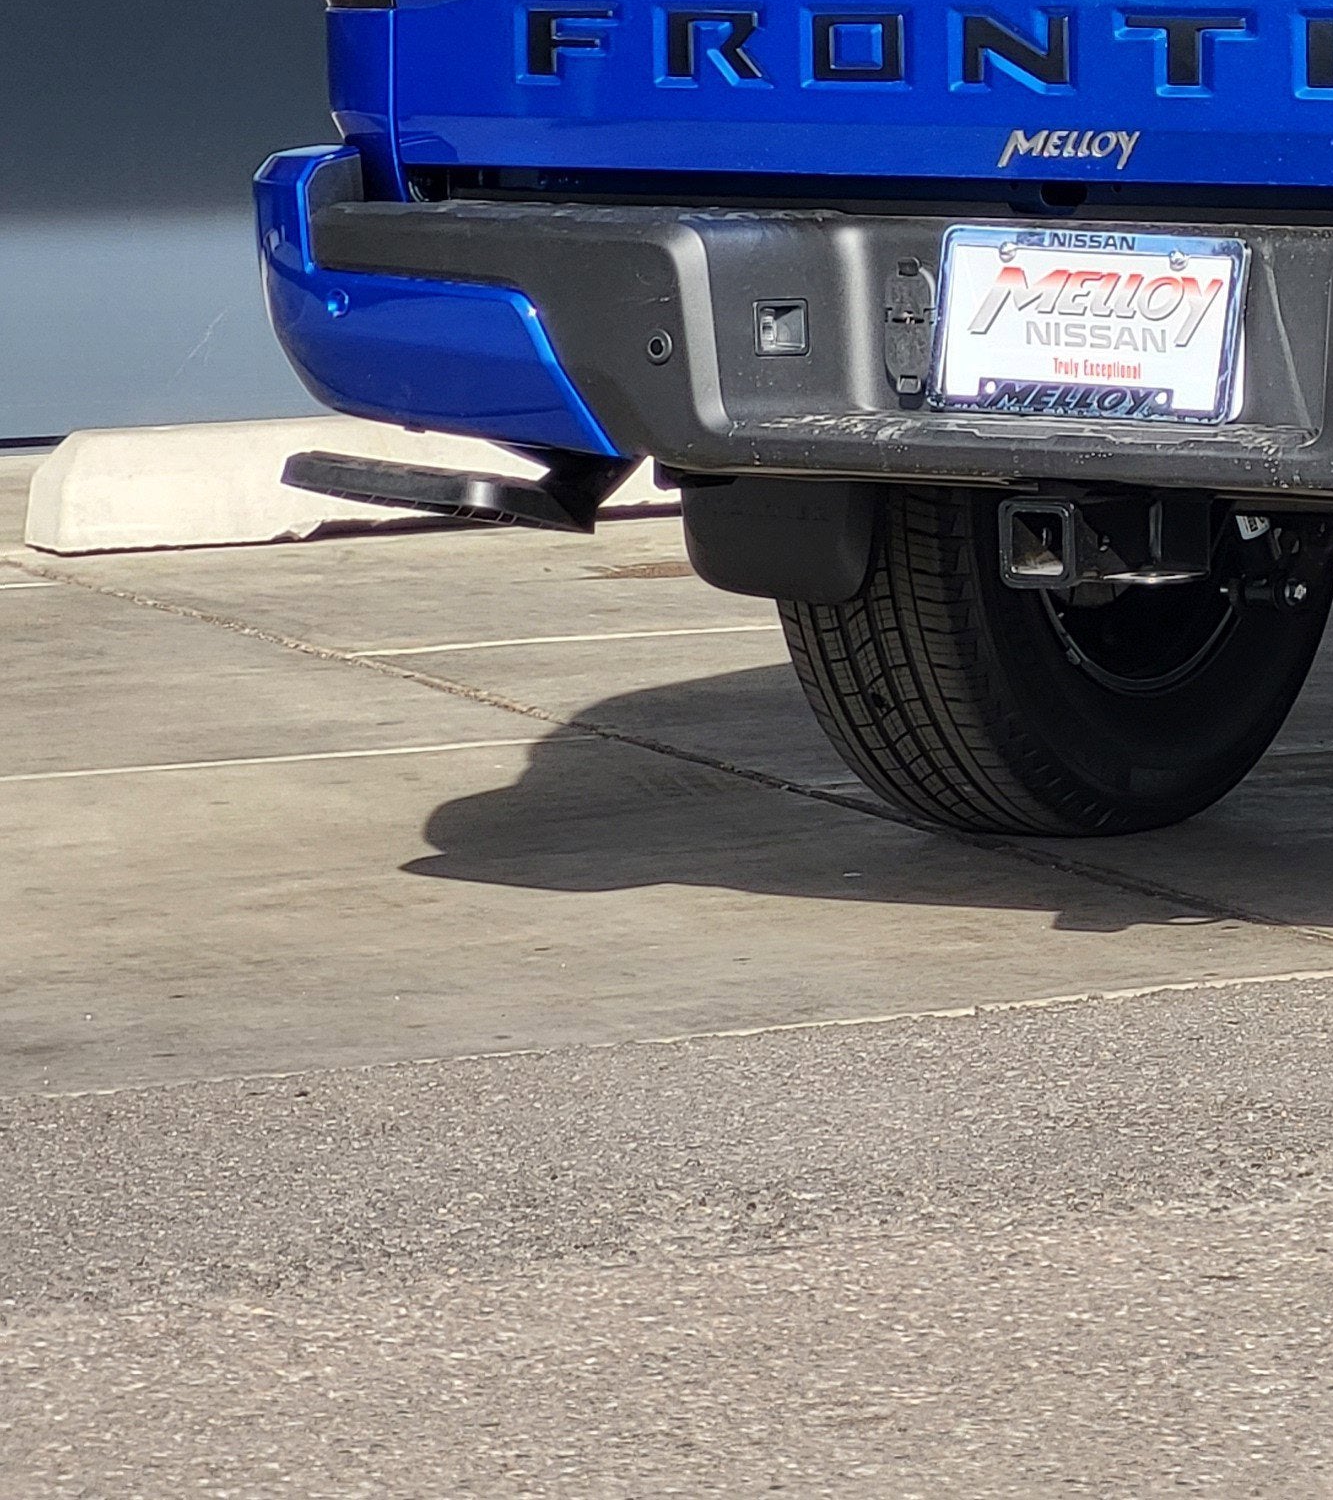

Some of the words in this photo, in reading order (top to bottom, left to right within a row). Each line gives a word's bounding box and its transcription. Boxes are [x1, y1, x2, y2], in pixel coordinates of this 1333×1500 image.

[997, 129, 1140, 170] MELLOY
[1051, 231, 1136, 251] NISSAN
[968, 266, 1223, 348] MELLOY
[1026, 320, 1167, 353] NISSAN
[1053, 357, 1078, 378] Truly
[1084, 359, 1141, 380] Exceptional
[985, 381, 1154, 416] MELLOY
